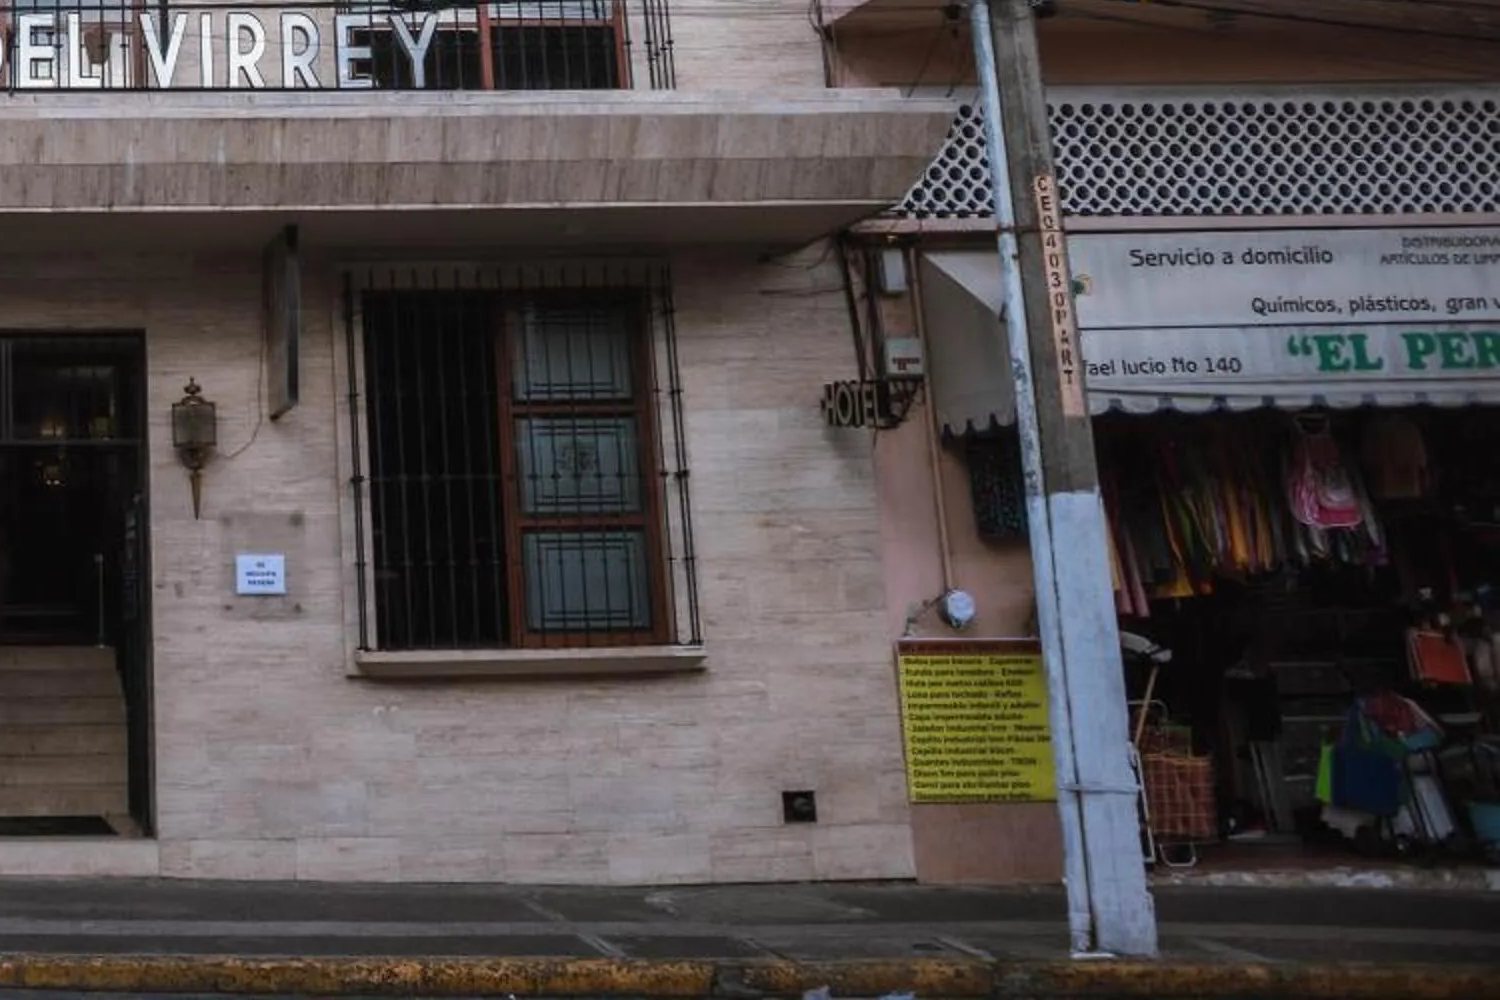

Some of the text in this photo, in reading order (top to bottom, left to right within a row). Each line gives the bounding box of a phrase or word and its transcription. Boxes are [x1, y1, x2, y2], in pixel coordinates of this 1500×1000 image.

[139, 10, 440, 89] VIRREY
[1129, 246, 1334, 267] Servicio a domicilio
[1252, 296, 1342, 316] Químicos,
[1350, 295, 1436, 317] plásticos,
[1446, 297, 1487, 315] gran
[1206, 357, 1242, 373] 140
[1401, 329, 1500, 370] PER
[821, 380, 898, 429] HOTEL
